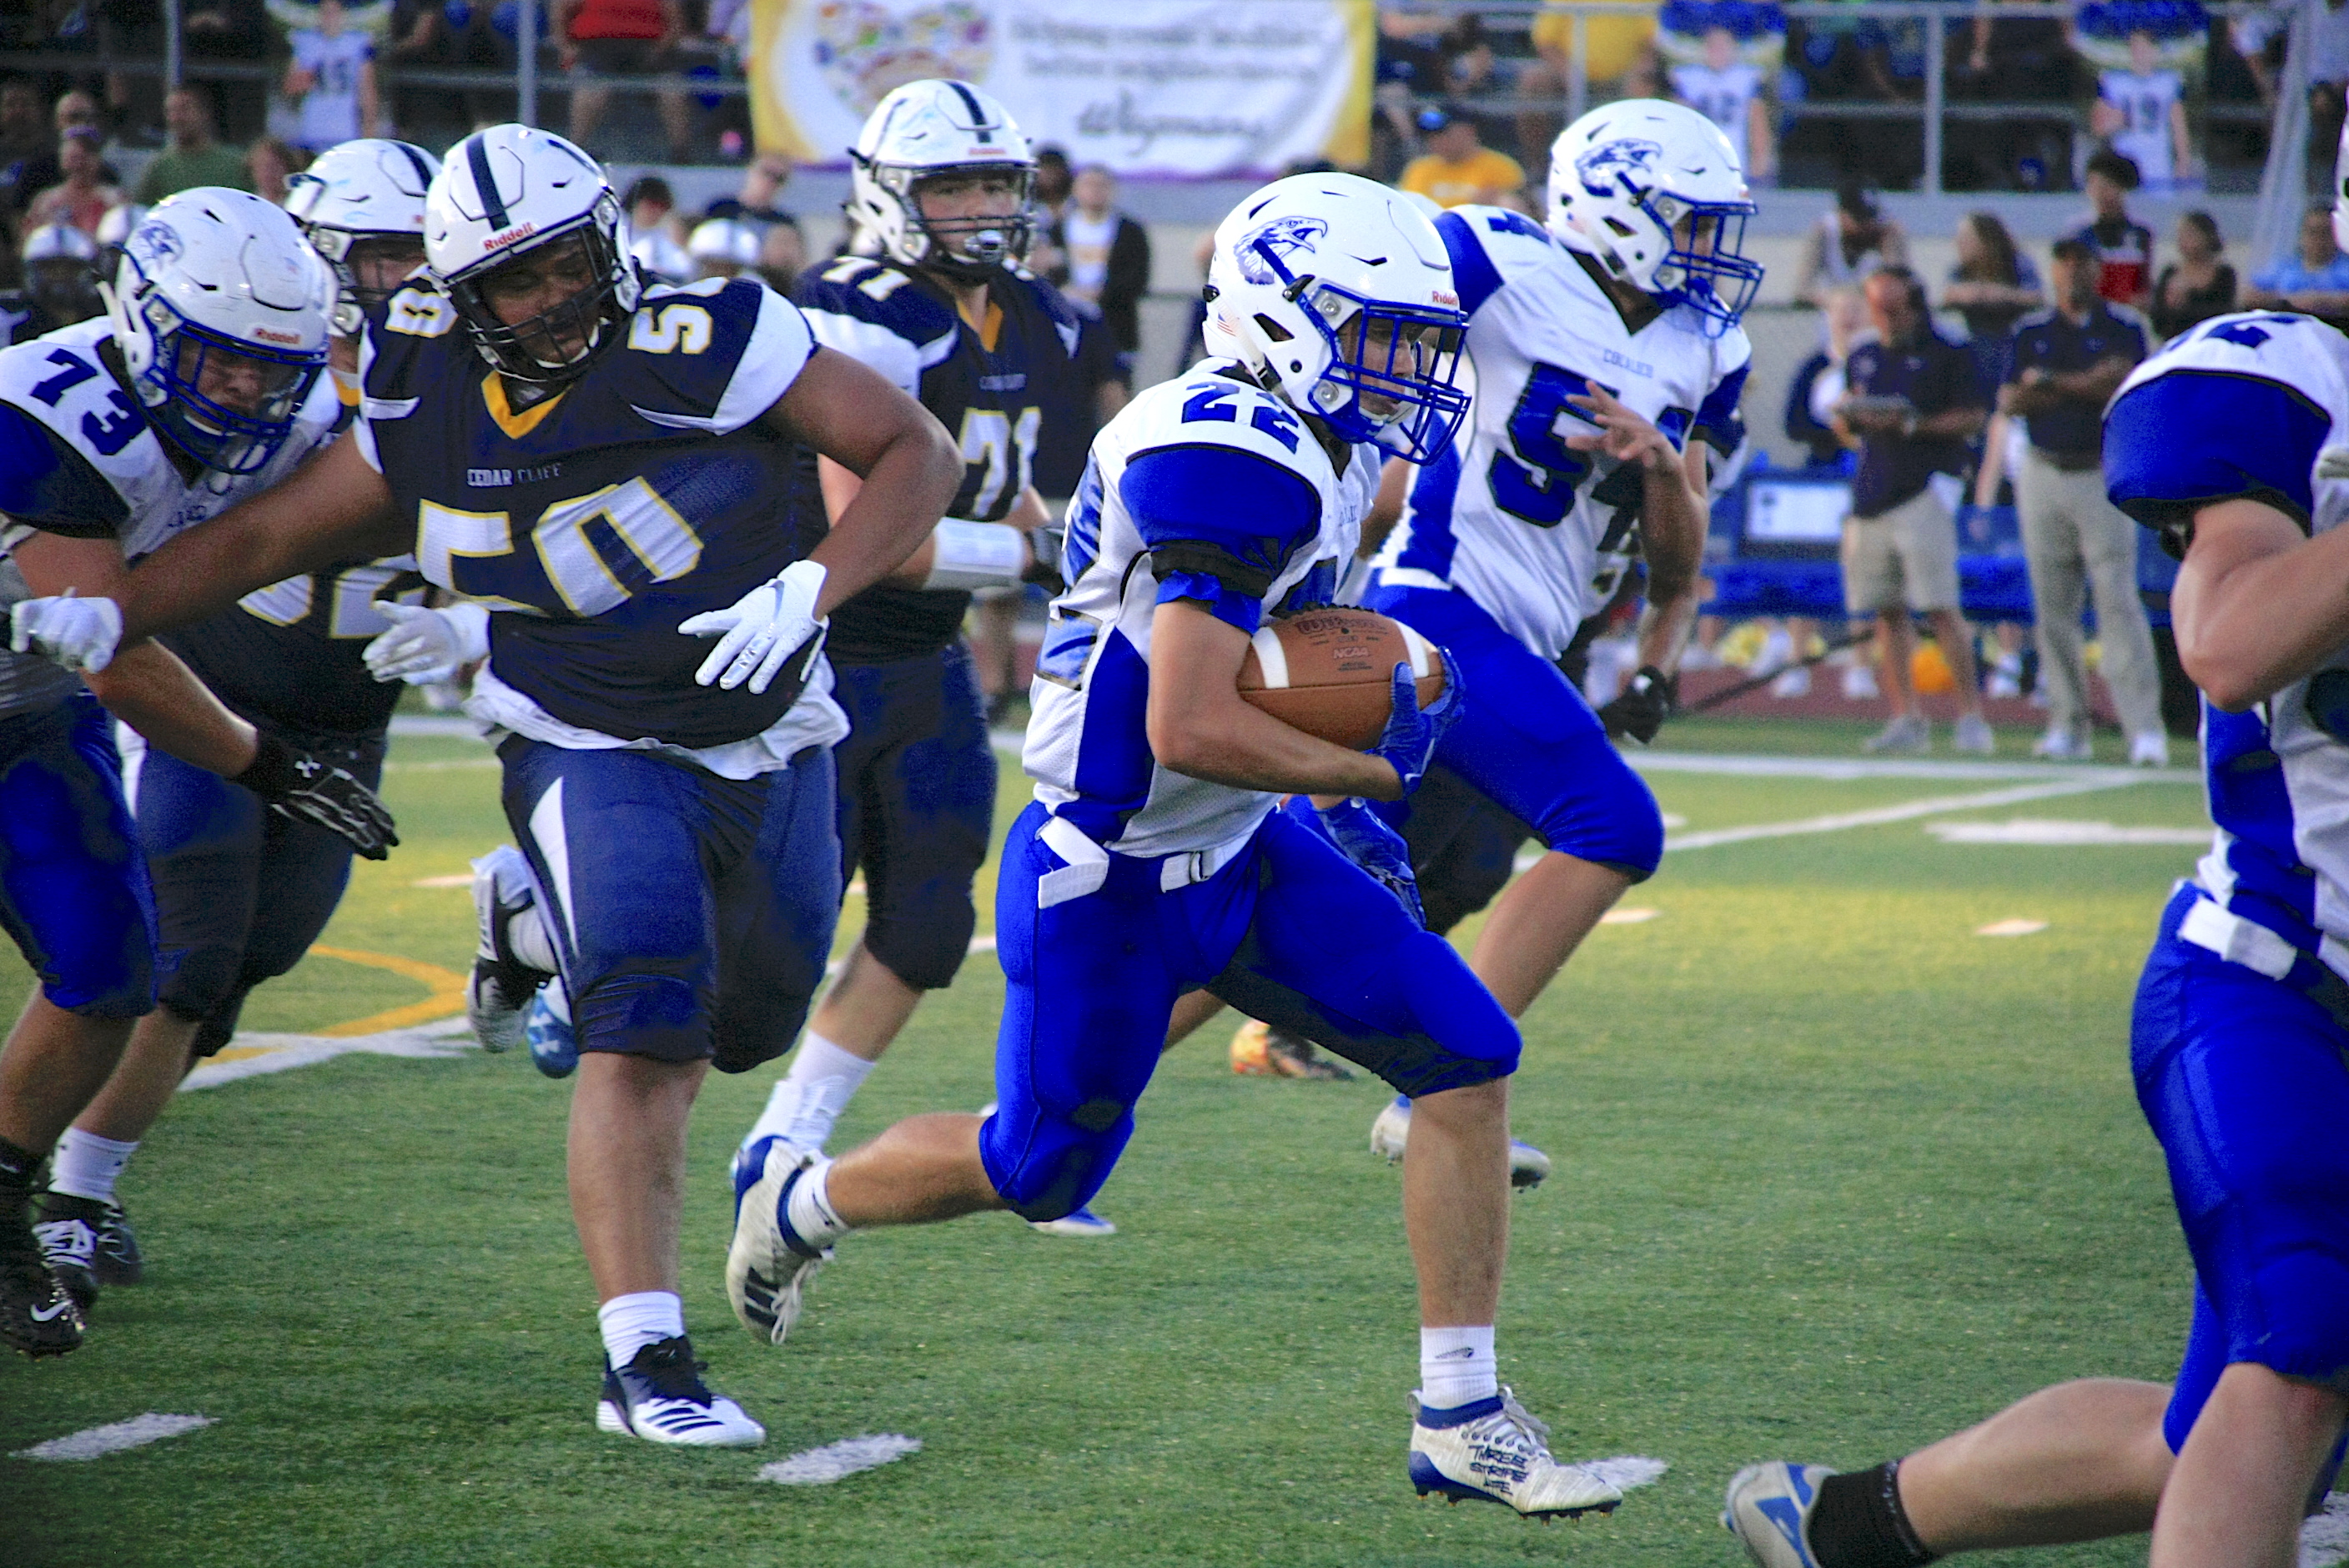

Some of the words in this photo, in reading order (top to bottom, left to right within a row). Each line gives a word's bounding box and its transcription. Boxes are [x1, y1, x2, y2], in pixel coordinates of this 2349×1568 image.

[484, 222, 534, 250] Riddell
[1432, 290, 1459, 307] Riddel
[29, 348, 147, 455] 73
[1181, 381, 1301, 455] 22
[467, 469, 513, 487] CEDAR
[959, 406, 1043, 519] 71
[415, 475, 705, 618] 50
